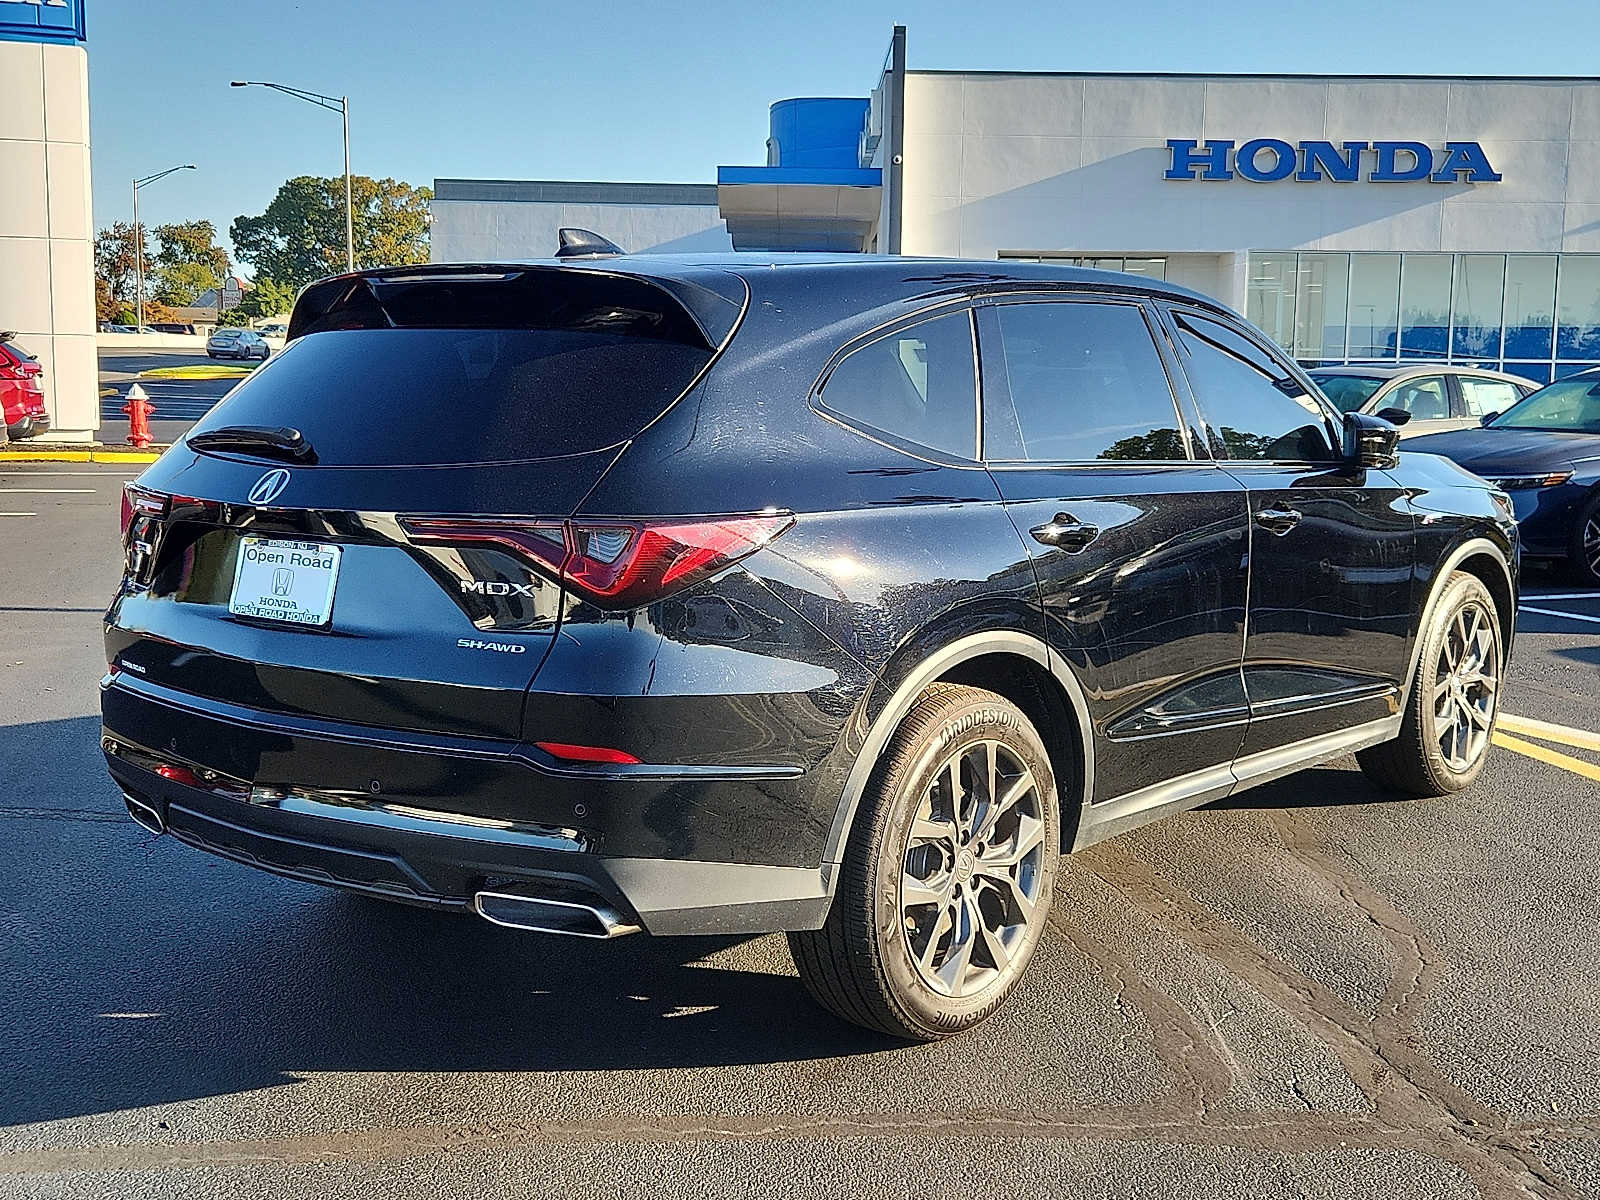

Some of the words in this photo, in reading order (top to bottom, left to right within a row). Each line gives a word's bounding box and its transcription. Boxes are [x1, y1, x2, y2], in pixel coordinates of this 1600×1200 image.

[1164, 138, 1502, 183] HONDA
[246, 548, 284, 564] Open
[290, 553, 333, 569] Road
[460, 580, 535, 598] MDX
[258, 596, 298, 610] HONDA
[234, 604, 258, 615] OPEN
[258, 607, 285, 619] ROAD
[286, 611, 320, 624] HONDA
